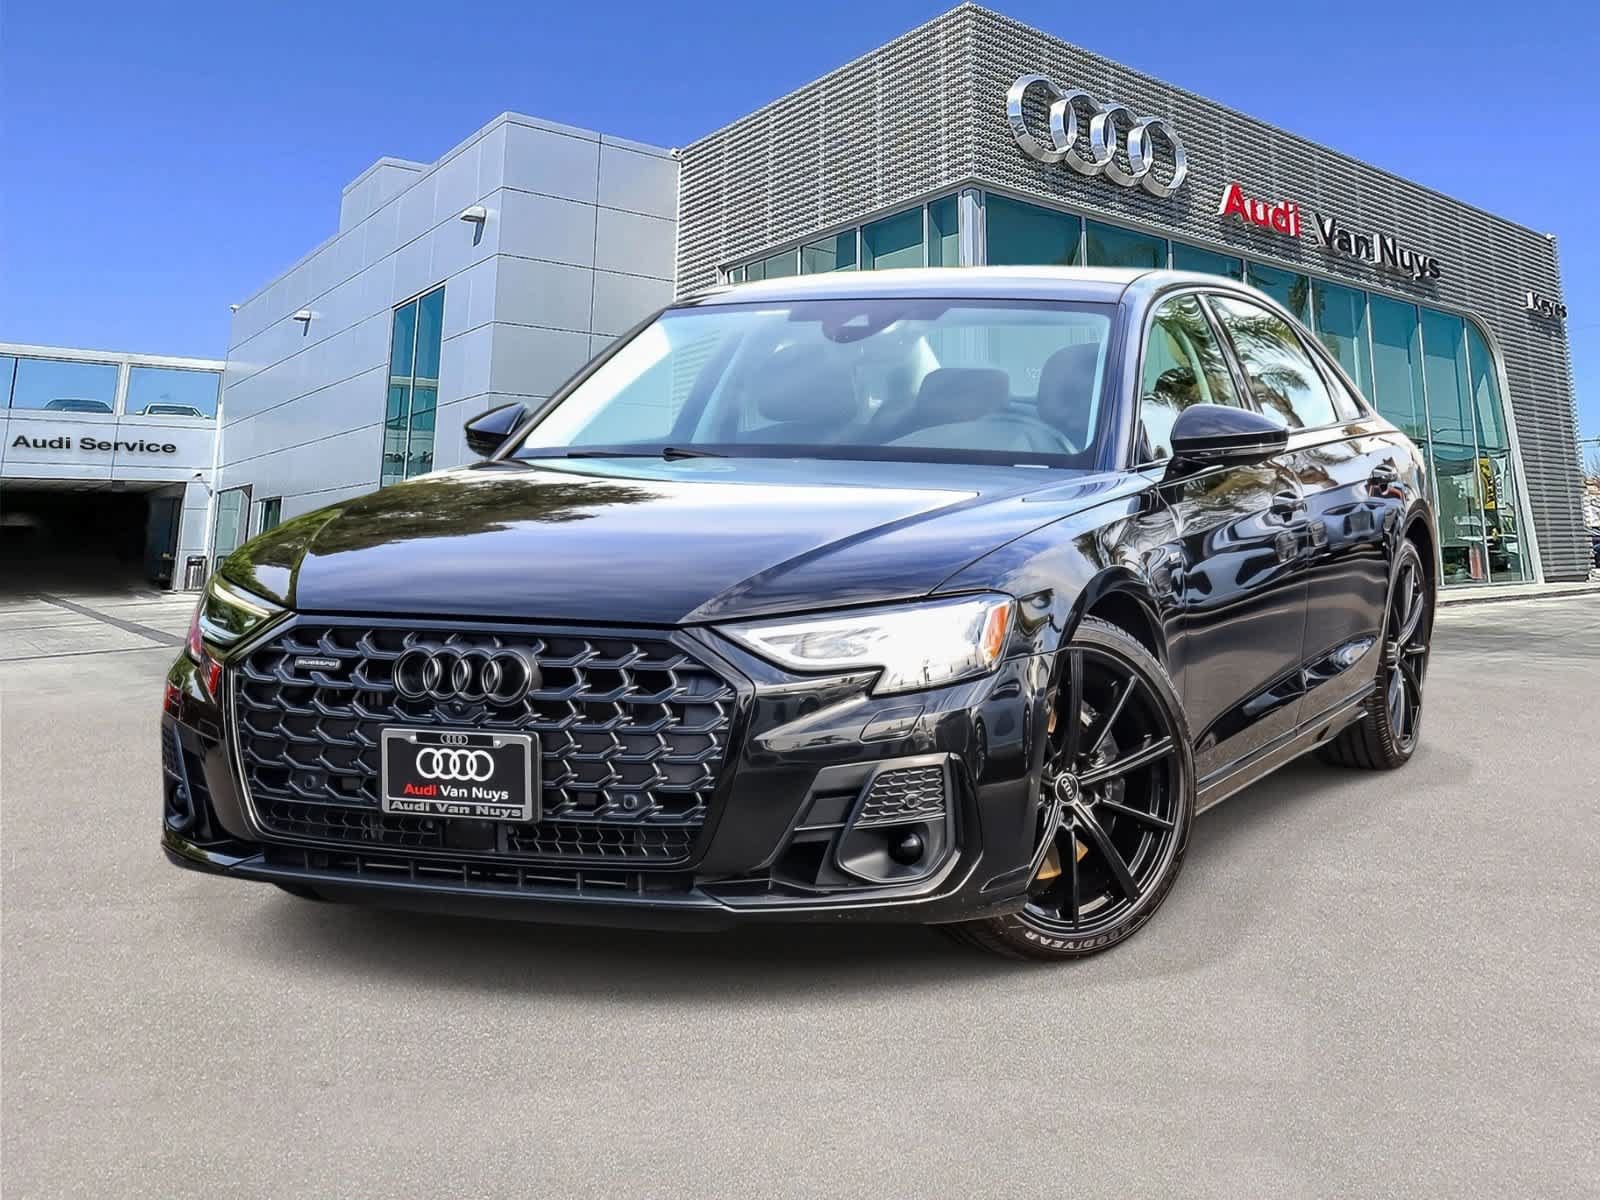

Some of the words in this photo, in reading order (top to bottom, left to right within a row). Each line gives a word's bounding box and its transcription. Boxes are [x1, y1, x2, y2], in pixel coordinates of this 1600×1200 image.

[1218, 182, 1302, 237] Audi
[1312, 213, 1370, 259] Van
[1374, 234, 1441, 280] Nuys
[12, 435, 71, 450] Audi
[80, 437, 177, 453] Service
[404, 783, 437, 796] Audi
[440, 785, 468, 798] Van
[472, 787, 509, 801] Nuys
[391, 801, 430, 812] Audi
[436, 803, 470, 814] Van
[475, 805, 522, 818] Nuys
[1024, 926, 1127, 950] OODYEAR
